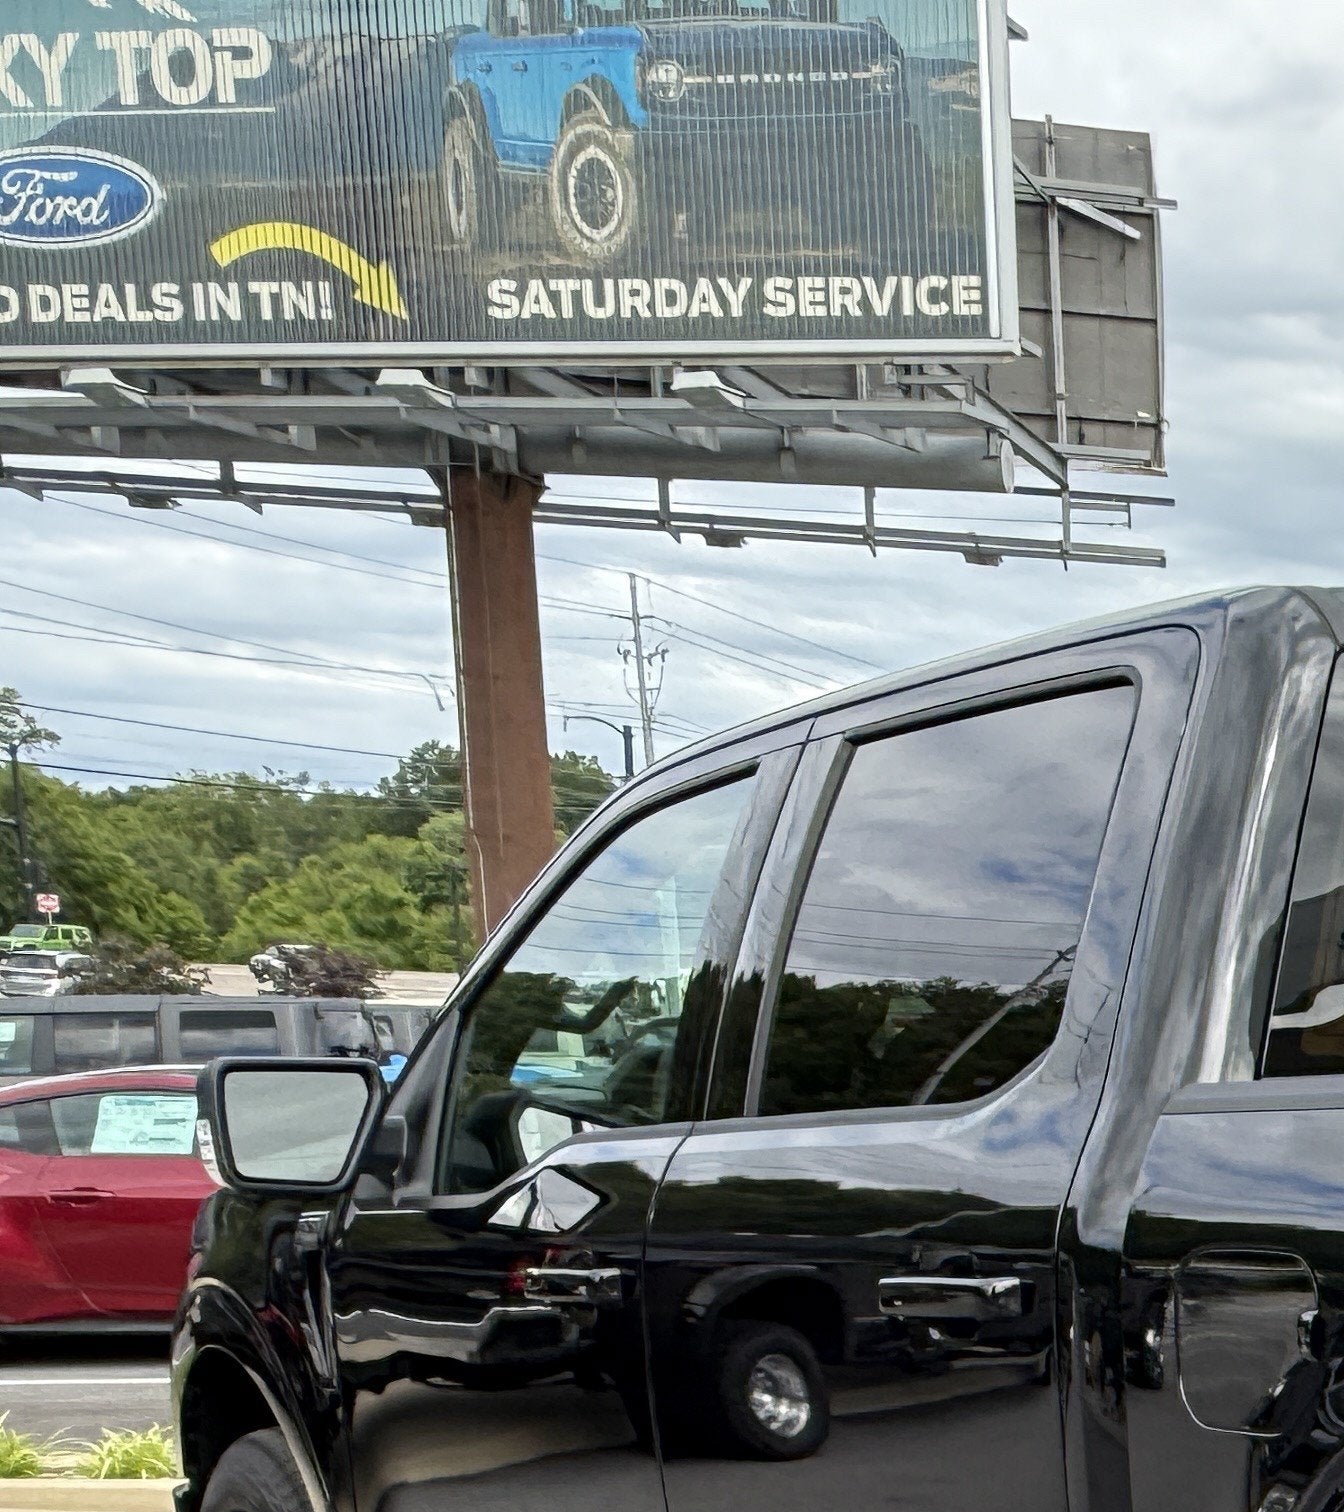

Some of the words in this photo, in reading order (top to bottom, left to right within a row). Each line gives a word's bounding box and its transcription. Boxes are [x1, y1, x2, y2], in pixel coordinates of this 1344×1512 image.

[95, 28, 272, 105] TOP
[0, 168, 111, 226] Ford
[27, 283, 184, 322] DEALS
[192, 282, 242, 321] IN
[249, 281, 333, 320] TN!
[487, 277, 753, 318] SATURDAY
[762, 275, 983, 316] SERVICE
